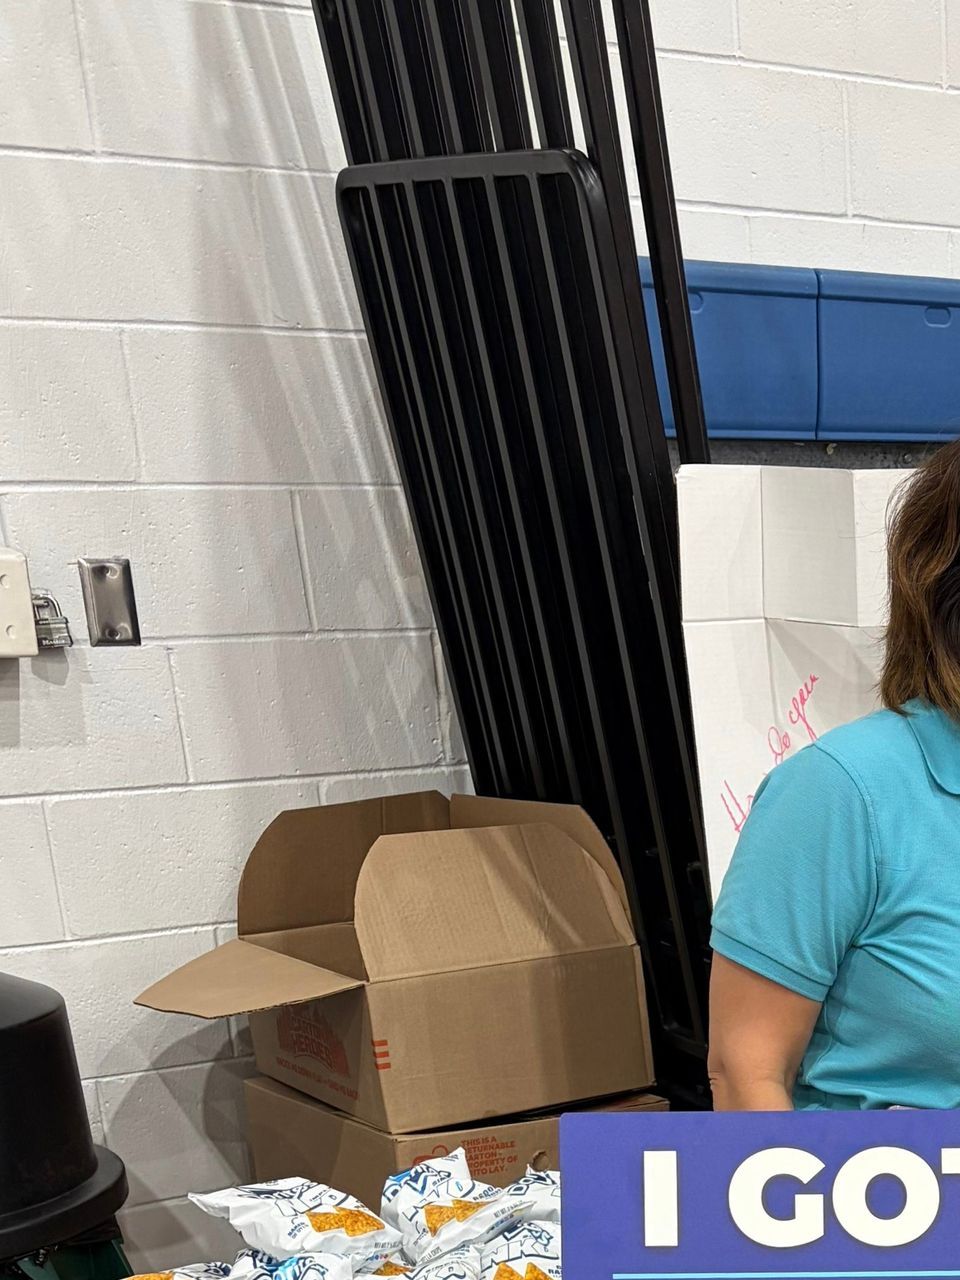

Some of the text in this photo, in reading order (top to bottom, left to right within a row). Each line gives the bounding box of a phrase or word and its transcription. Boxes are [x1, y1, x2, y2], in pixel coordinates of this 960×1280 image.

[461, 1138, 480, 1147] THIS
[467, 1141, 516, 1154] ETURNABLE
[506, 1155, 519, 1164] OF
[643, 1150, 678, 1247] I
